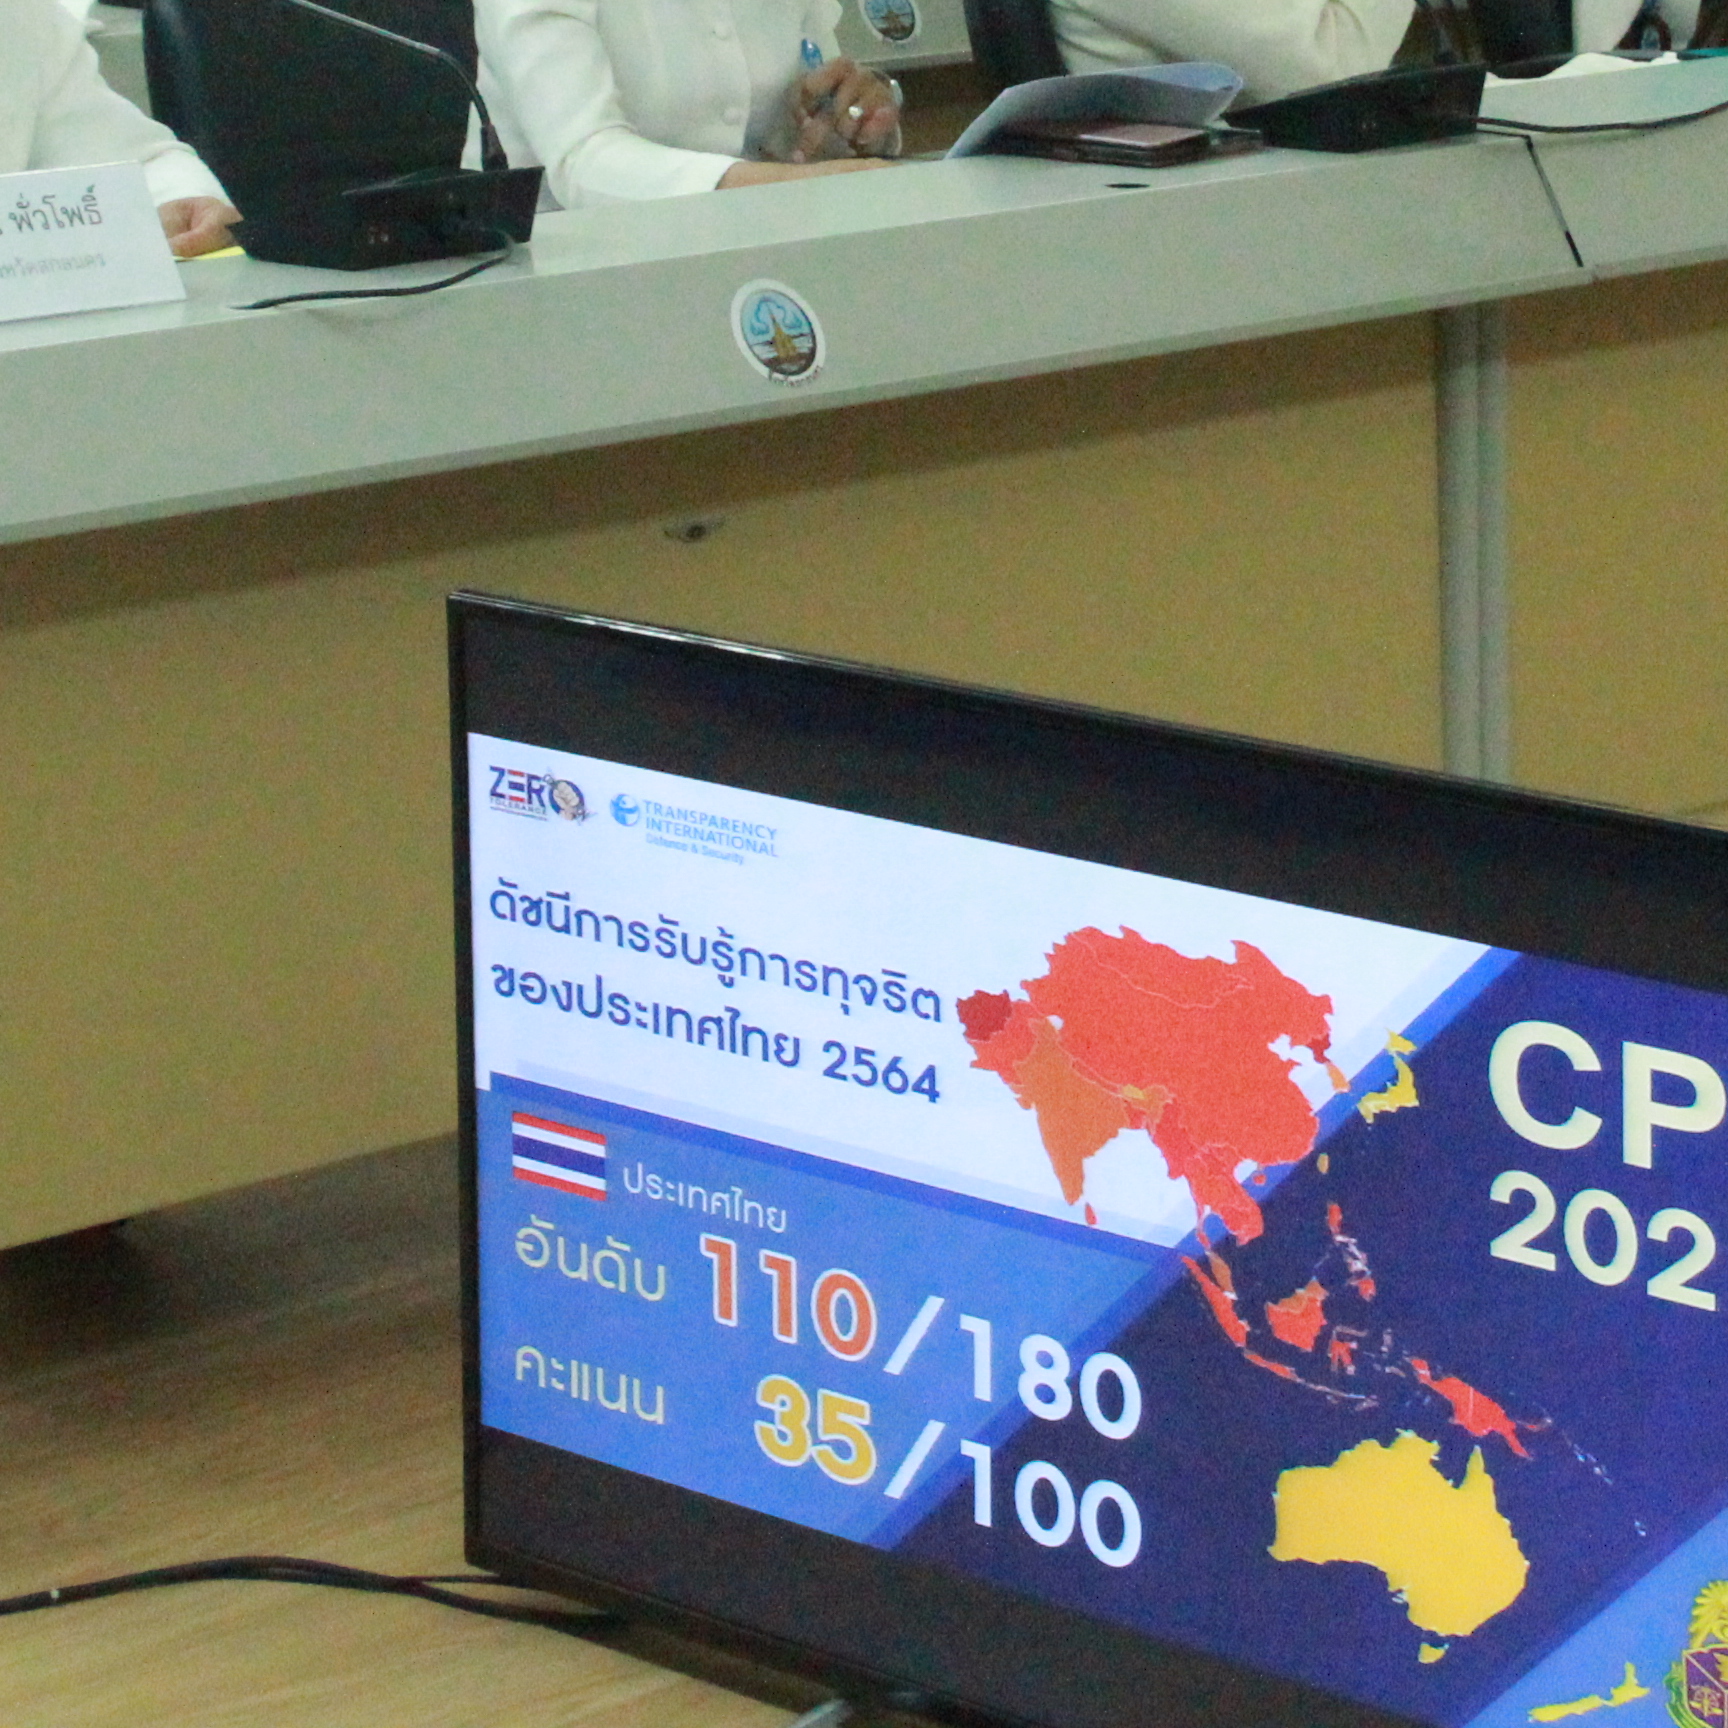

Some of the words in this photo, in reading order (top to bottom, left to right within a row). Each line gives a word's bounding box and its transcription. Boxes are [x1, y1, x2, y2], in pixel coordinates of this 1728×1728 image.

[489, 765, 585, 821] ZERO
[489, 797, 548, 815] TOLERANCE
[643, 799, 779, 841] TRANSPARENCY
[646, 820, 779, 857] INTERNATIONAL
[489, 876, 942, 1022] ดัชนีการรับรู้การทุจริต
[490, 962, 800, 1067] ของประเทศไทย
[822, 1039, 940, 1104] 2564
[623, 1162, 787, 1233] ประเทศไทย
[515, 1214, 665, 1302] อันดับ
[700, 1233, 1142, 1440] 110/180
[514, 1344, 664, 1425] คะแนน
[754, 1374, 1142, 1568] 35/100
